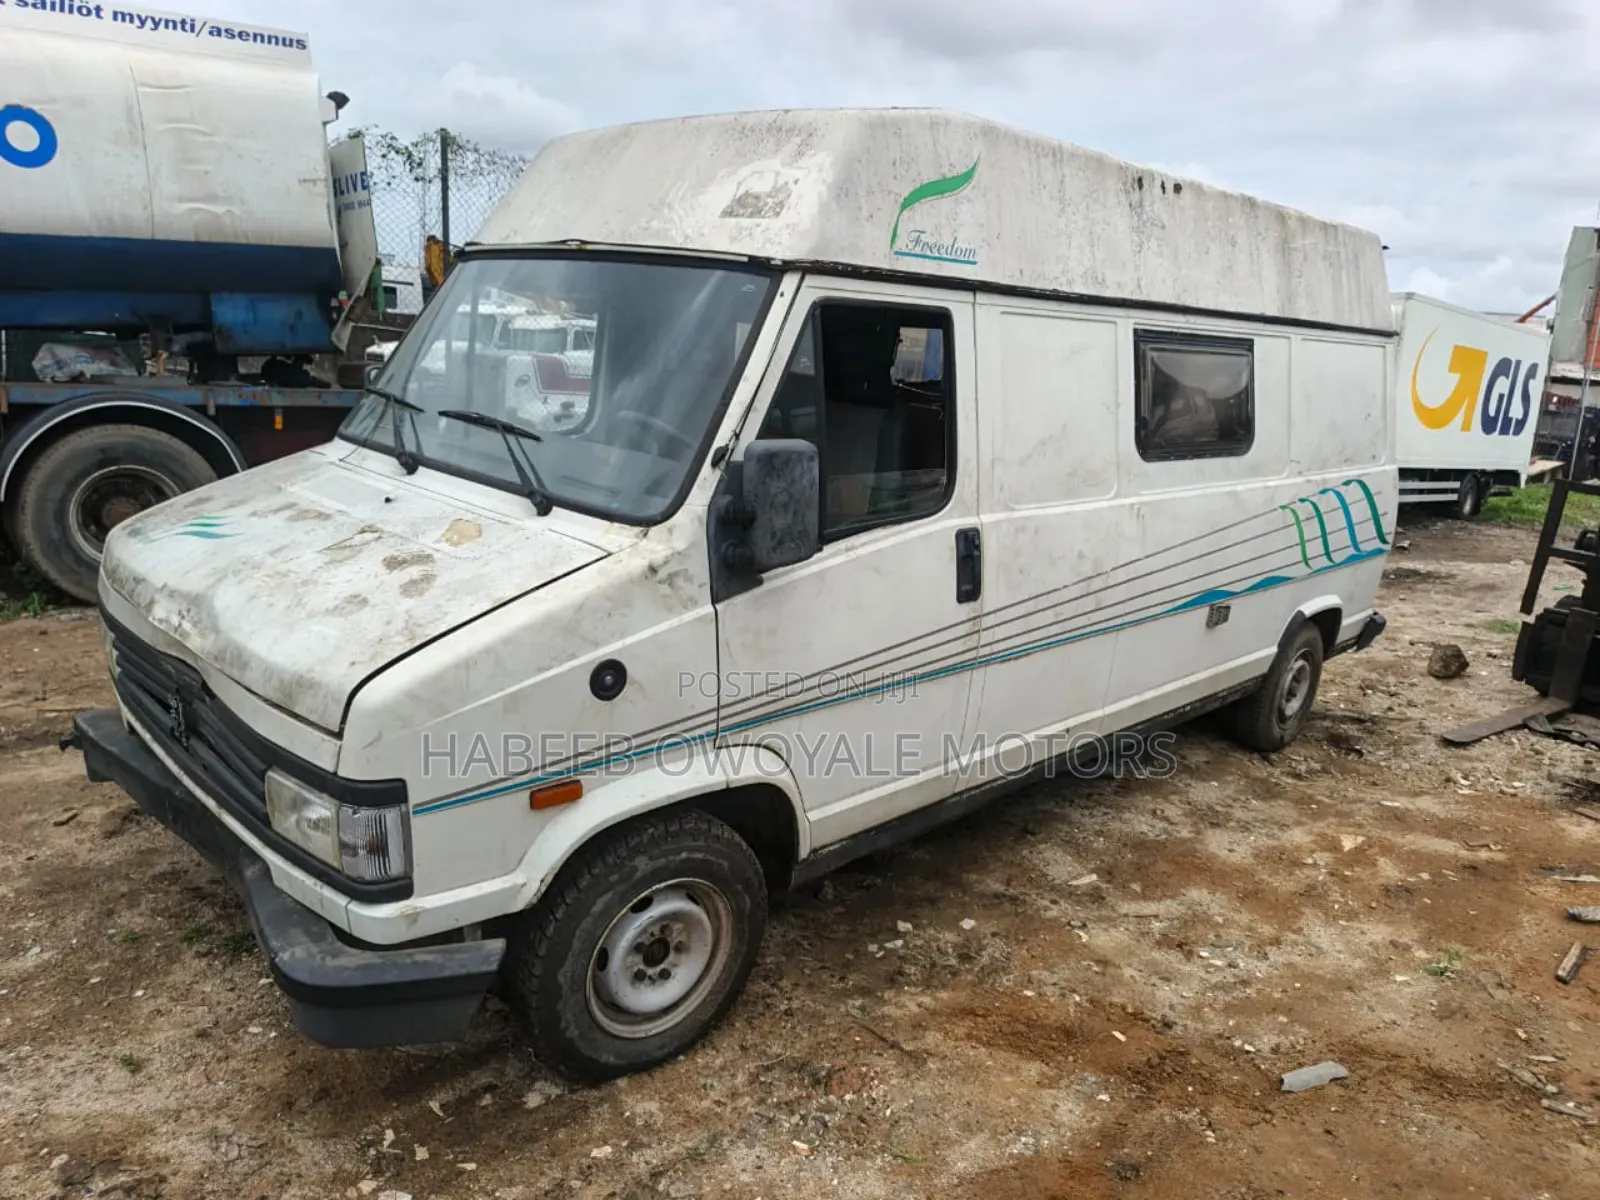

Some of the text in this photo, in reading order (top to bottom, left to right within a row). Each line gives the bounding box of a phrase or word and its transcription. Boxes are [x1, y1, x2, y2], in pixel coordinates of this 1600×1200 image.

[112, 9, 307, 50] myynti/asennus
[905, 229, 977, 260] Freedom
[1480, 356, 1539, 437] GLS
